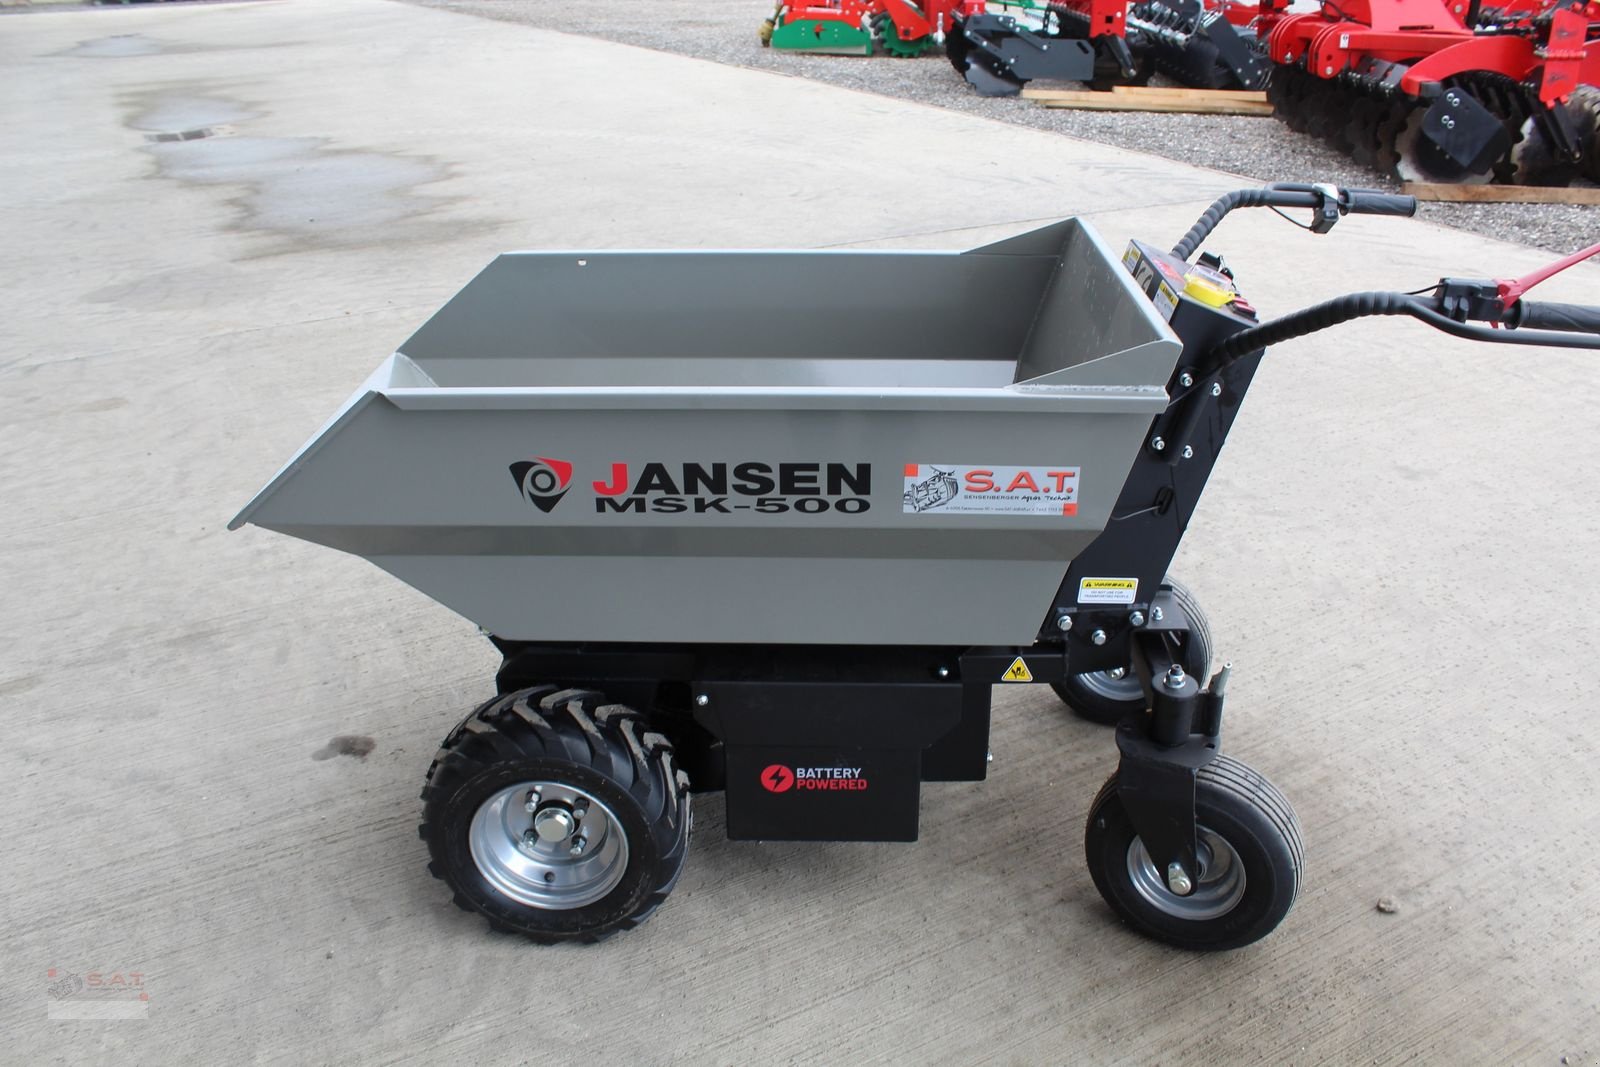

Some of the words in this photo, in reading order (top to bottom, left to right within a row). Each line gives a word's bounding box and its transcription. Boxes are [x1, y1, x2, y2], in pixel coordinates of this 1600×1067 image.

[592, 462, 872, 497] JANSEN
[963, 470, 1077, 494] S.A.T.
[594, 497, 872, 514] MSK-500
[796, 767, 862, 779] BATTERY
[796, 779, 868, 790] POWERED
